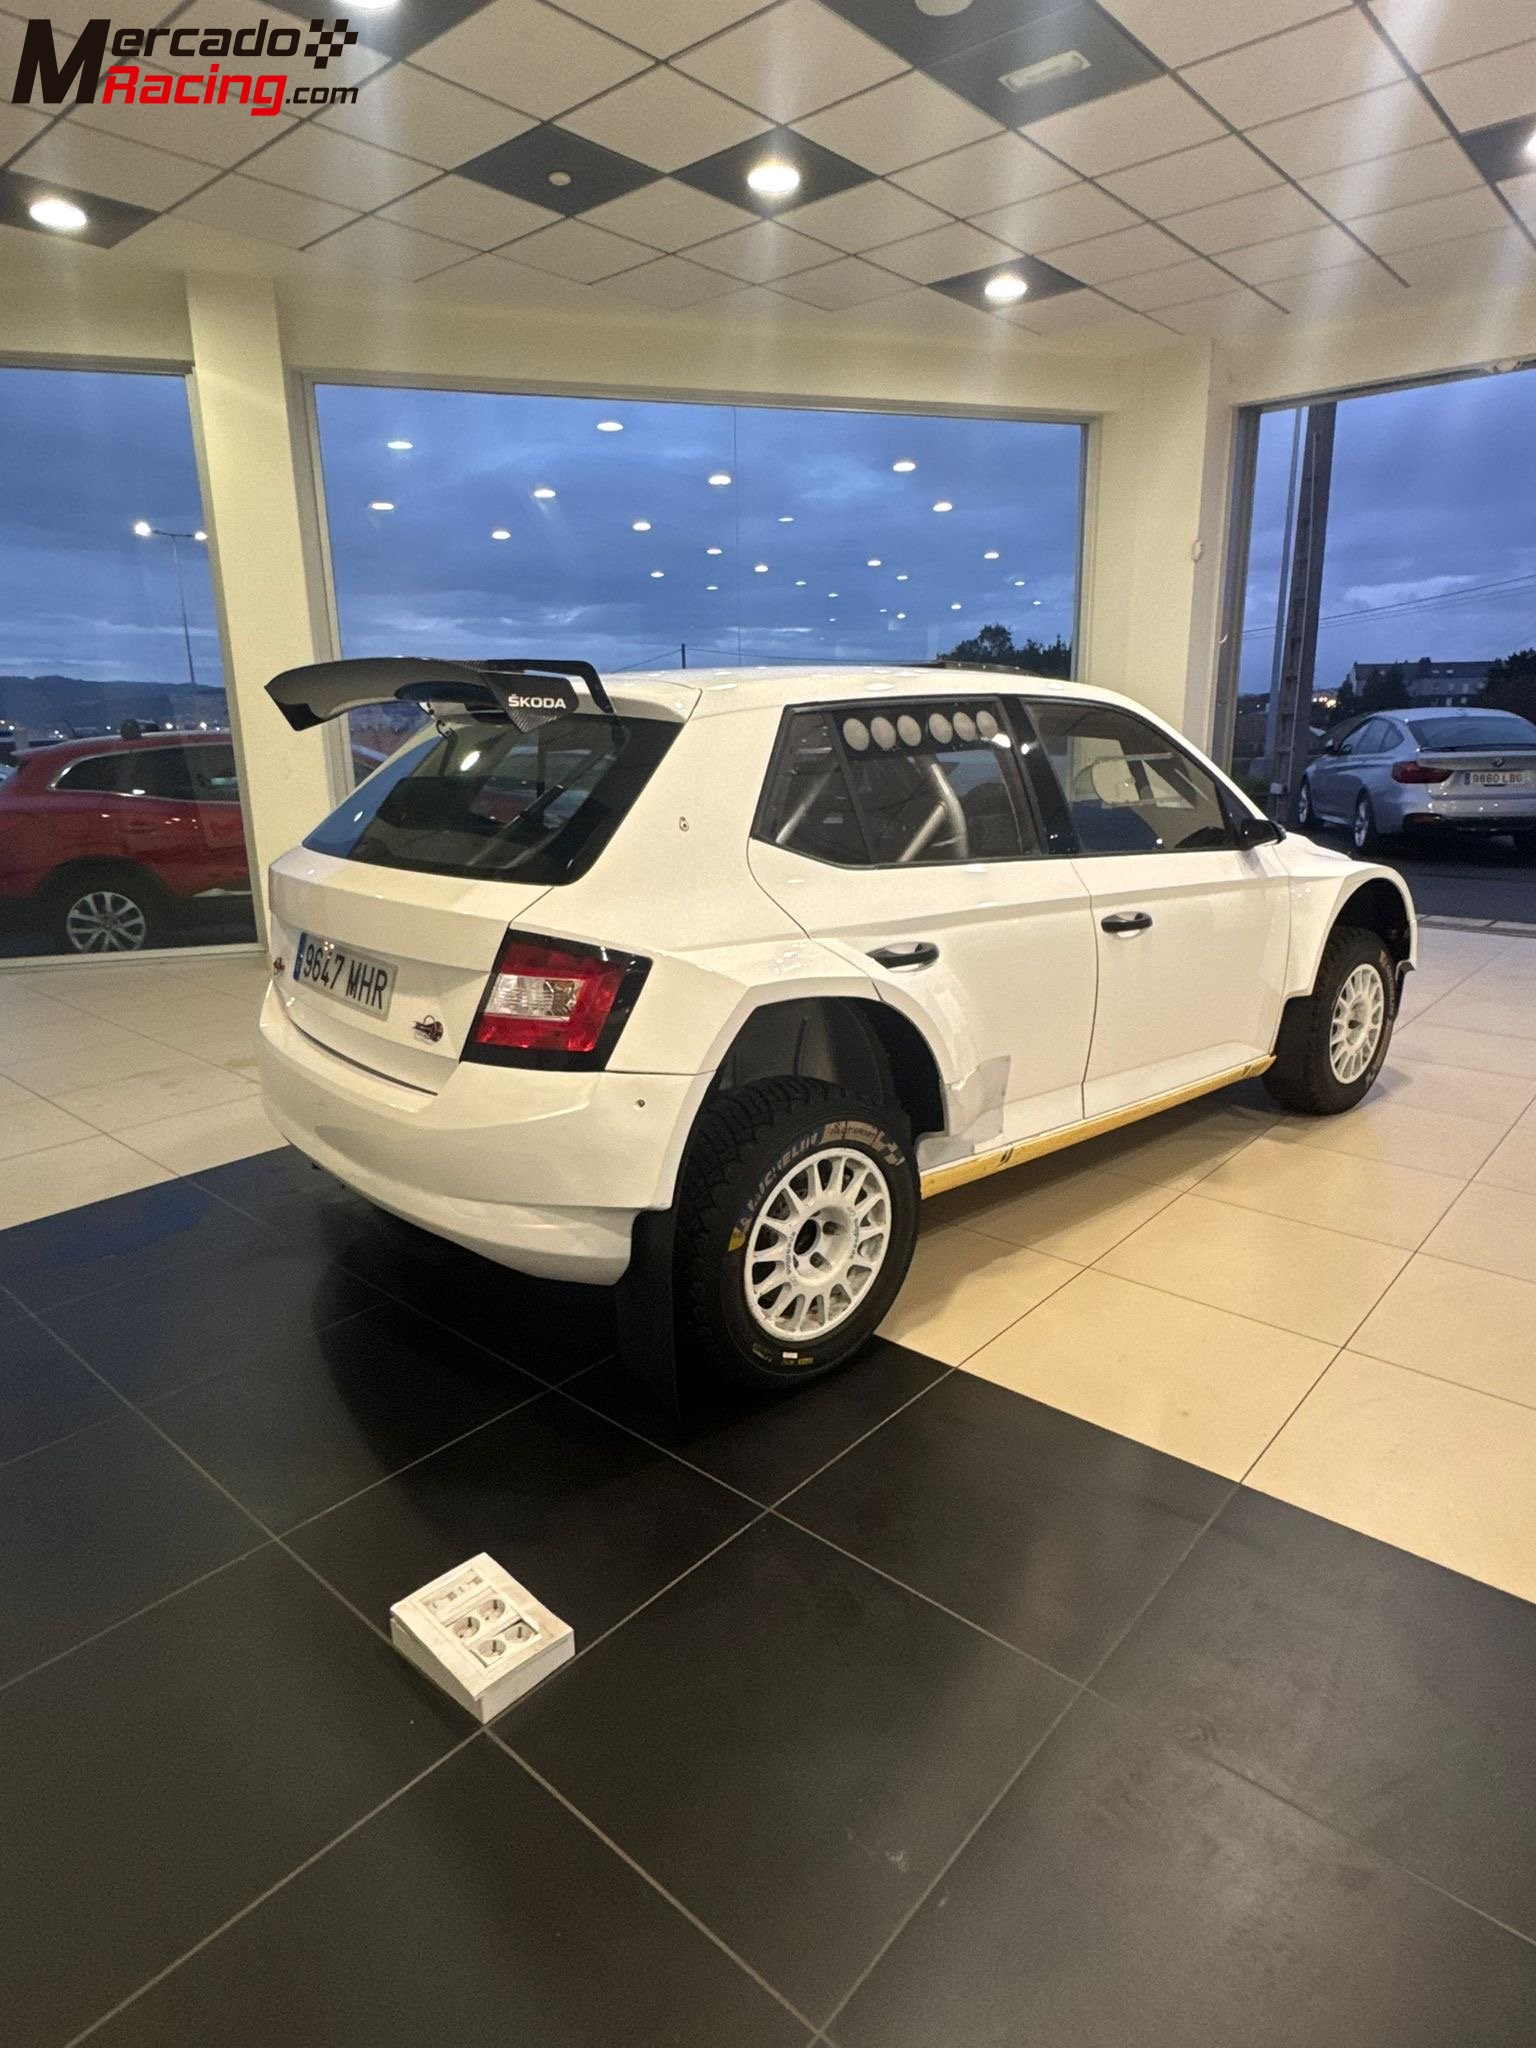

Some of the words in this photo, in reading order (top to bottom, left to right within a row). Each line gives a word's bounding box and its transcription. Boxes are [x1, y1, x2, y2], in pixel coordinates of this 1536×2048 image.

[508, 693, 567, 709] ŠKODA
[303, 944, 346, 990] 9647
[345, 959, 388, 1010] MHR
